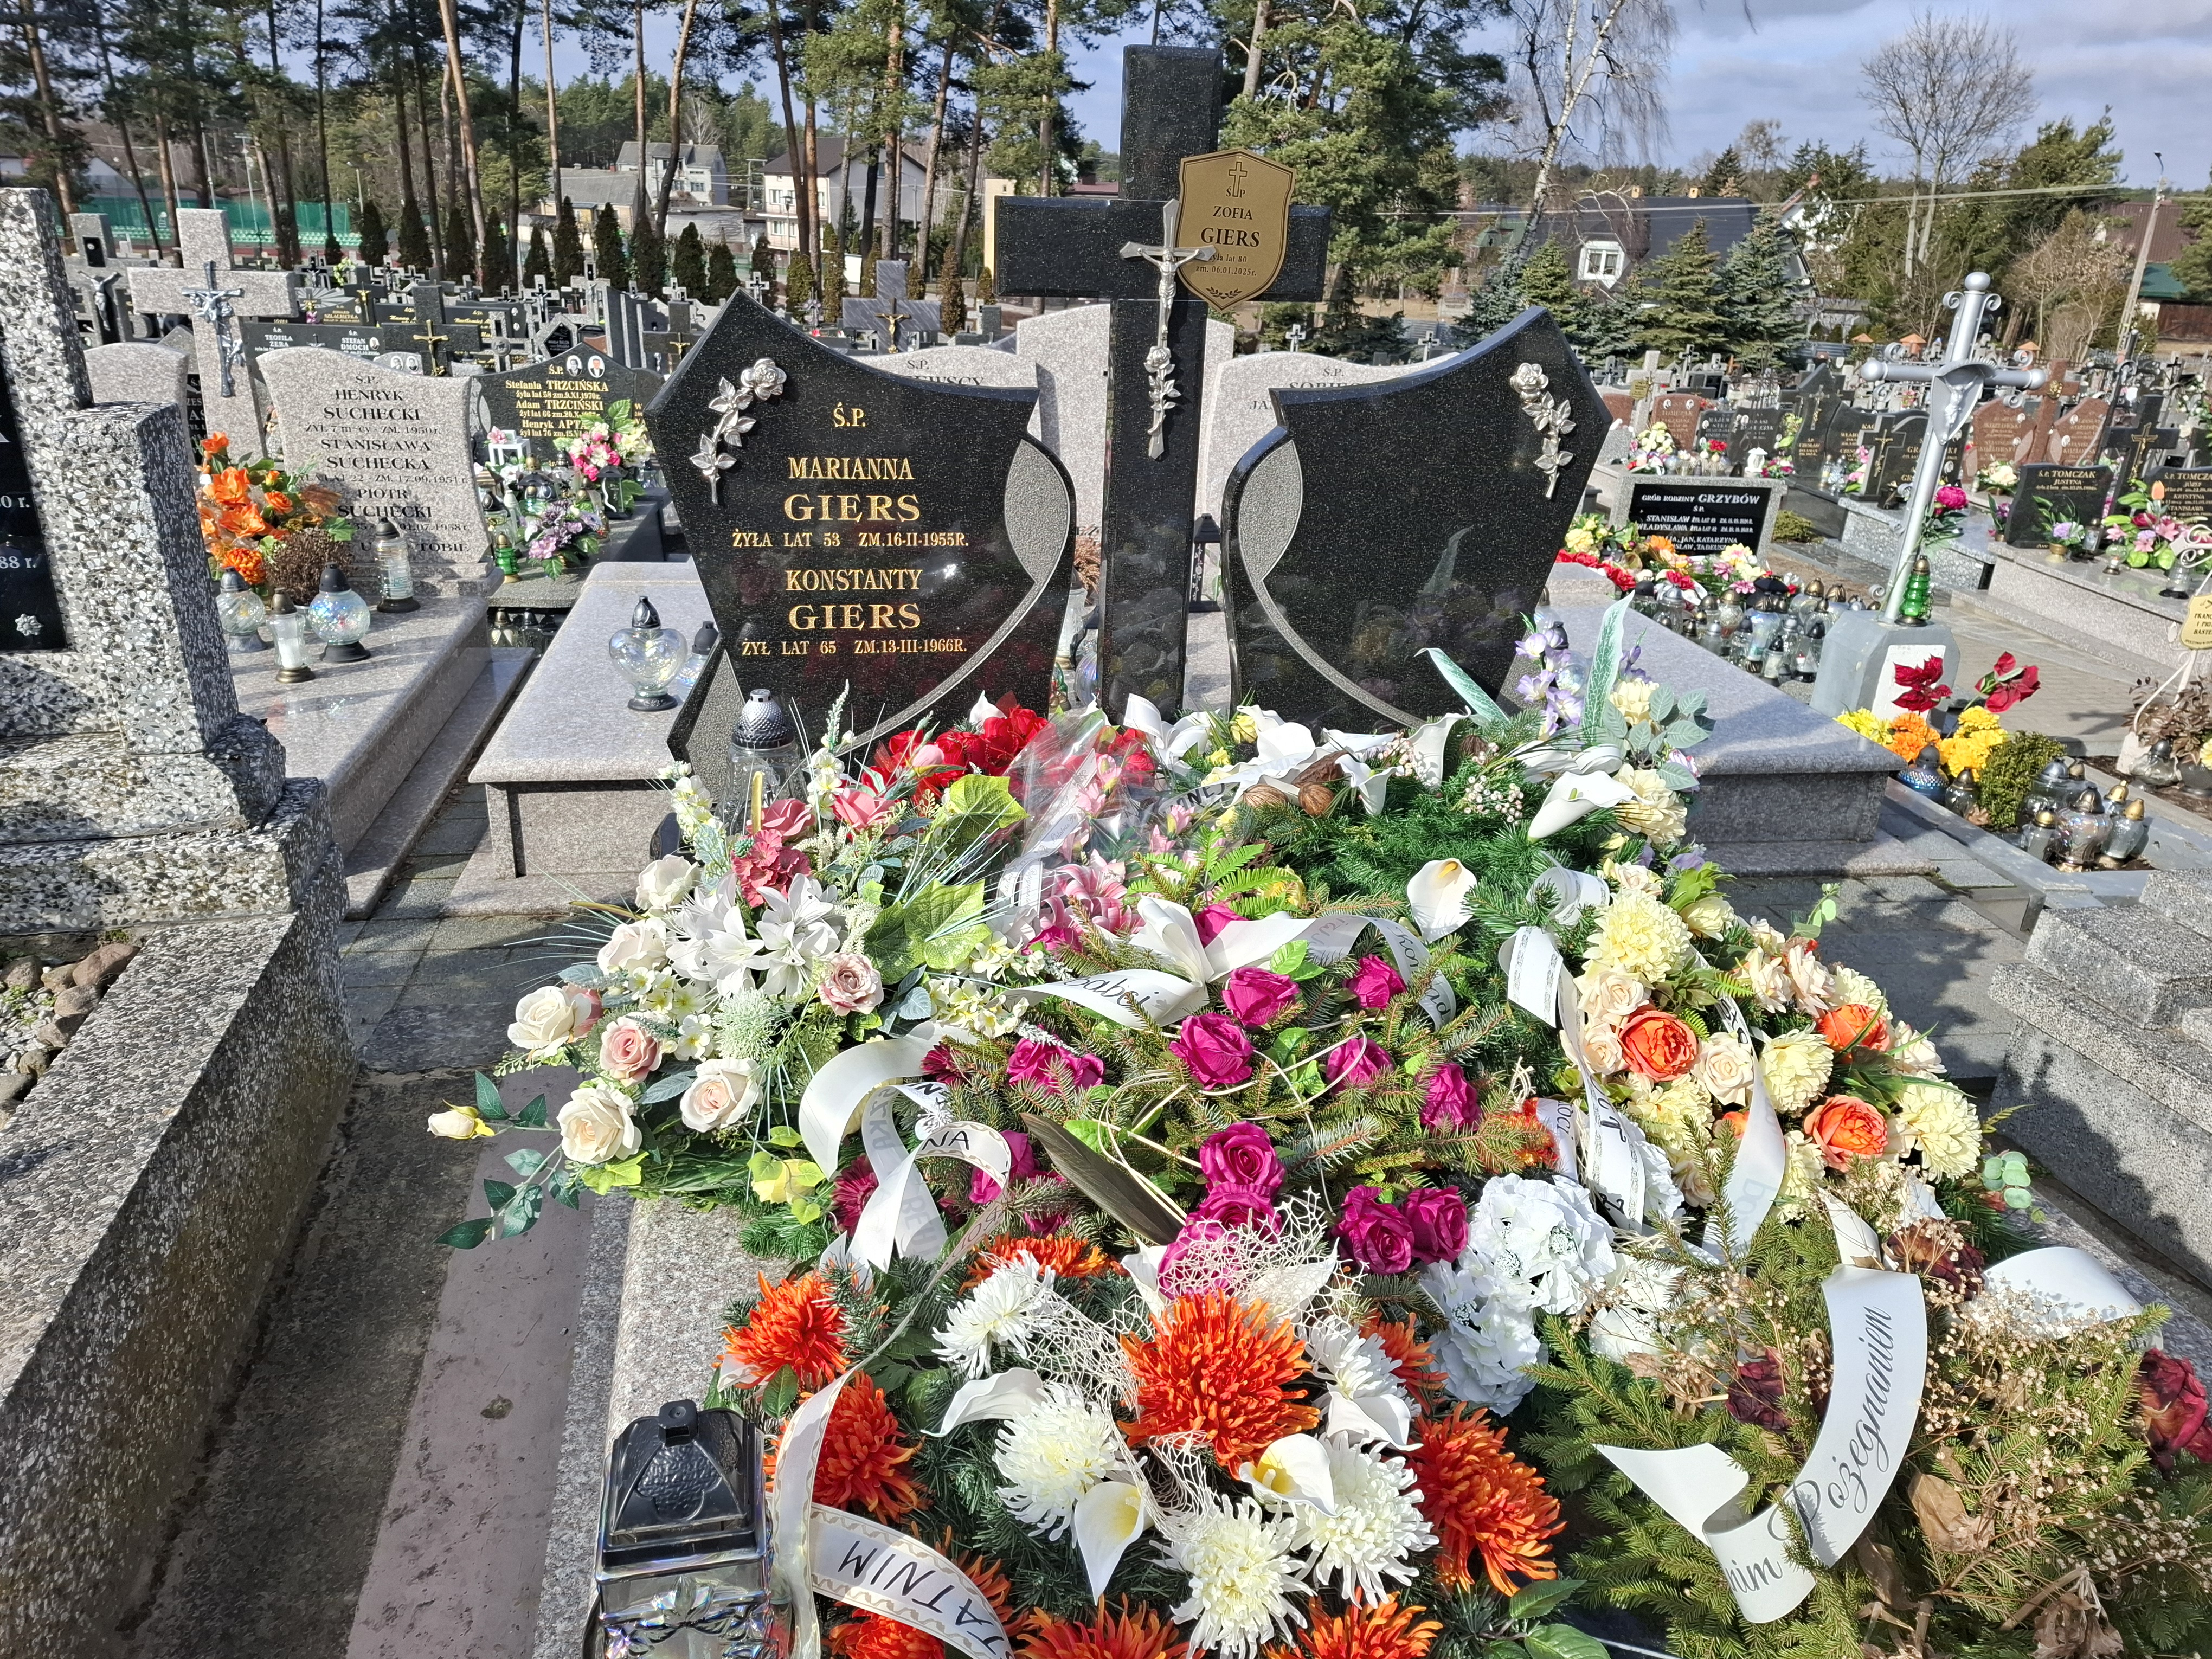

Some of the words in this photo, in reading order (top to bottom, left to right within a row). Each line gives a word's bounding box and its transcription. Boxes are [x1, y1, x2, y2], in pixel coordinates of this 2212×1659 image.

[1213, 205, 1253, 220] ZOFIA
[1201, 227, 1261, 247] GIERS
[1226, 254, 1236, 262] lat
[1211, 265, 1257, 276] 06.01.2025r.
[549, 364, 564, 375] Ś.P.
[546, 379, 609, 392] TRZCIŃSKA
[335, 389, 404, 401] HENRYK
[516, 400, 541, 409] Adam
[545, 398, 604, 411] TRZCIŃSKI
[324, 407, 421, 420] SUCHECKI
[832, 402, 866, 428] Ś.P.
[522, 420, 555, 430] Henryk
[321, 439, 432, 452] STANISŁAWA
[326, 456, 431, 470] SUCHECKA
[788, 456, 915, 480] MARIANNA
[2052, 470, 2097, 478] TOMCZAK
[358, 488, 409, 499] PIOTR
[1642, 493, 1661, 502] GRÓB
[1697, 493, 1761, 505] GRZYBÓW
[337, 505, 433, 518] SUCHECKI
[783, 493, 921, 522] GIERS
[1646, 515, 1690, 523] STANISŁAW
[1637, 523, 1688, 531] WŁADYSŁAWA
[732, 528, 773, 548] ŻYŁA
[783, 532, 813, 547] LAT
[824, 532, 840, 547] 53
[858, 532, 969, 548] ZM.16-II-1955R.
[418, 543, 470, 552] TOBIE
[25, 557, 37, 569] r.
[785, 569, 923, 591] KONSTANTY
[788, 603, 921, 631] GIERS
[742, 638, 770, 656] ŻYŁ
[781, 641, 809, 655] LAT
[820, 640, 837, 655] 65
[854, 639, 968, 654] ZM.13-III-1966R.
[1767, 1305, 1893, 1549] Pożegnaniem
